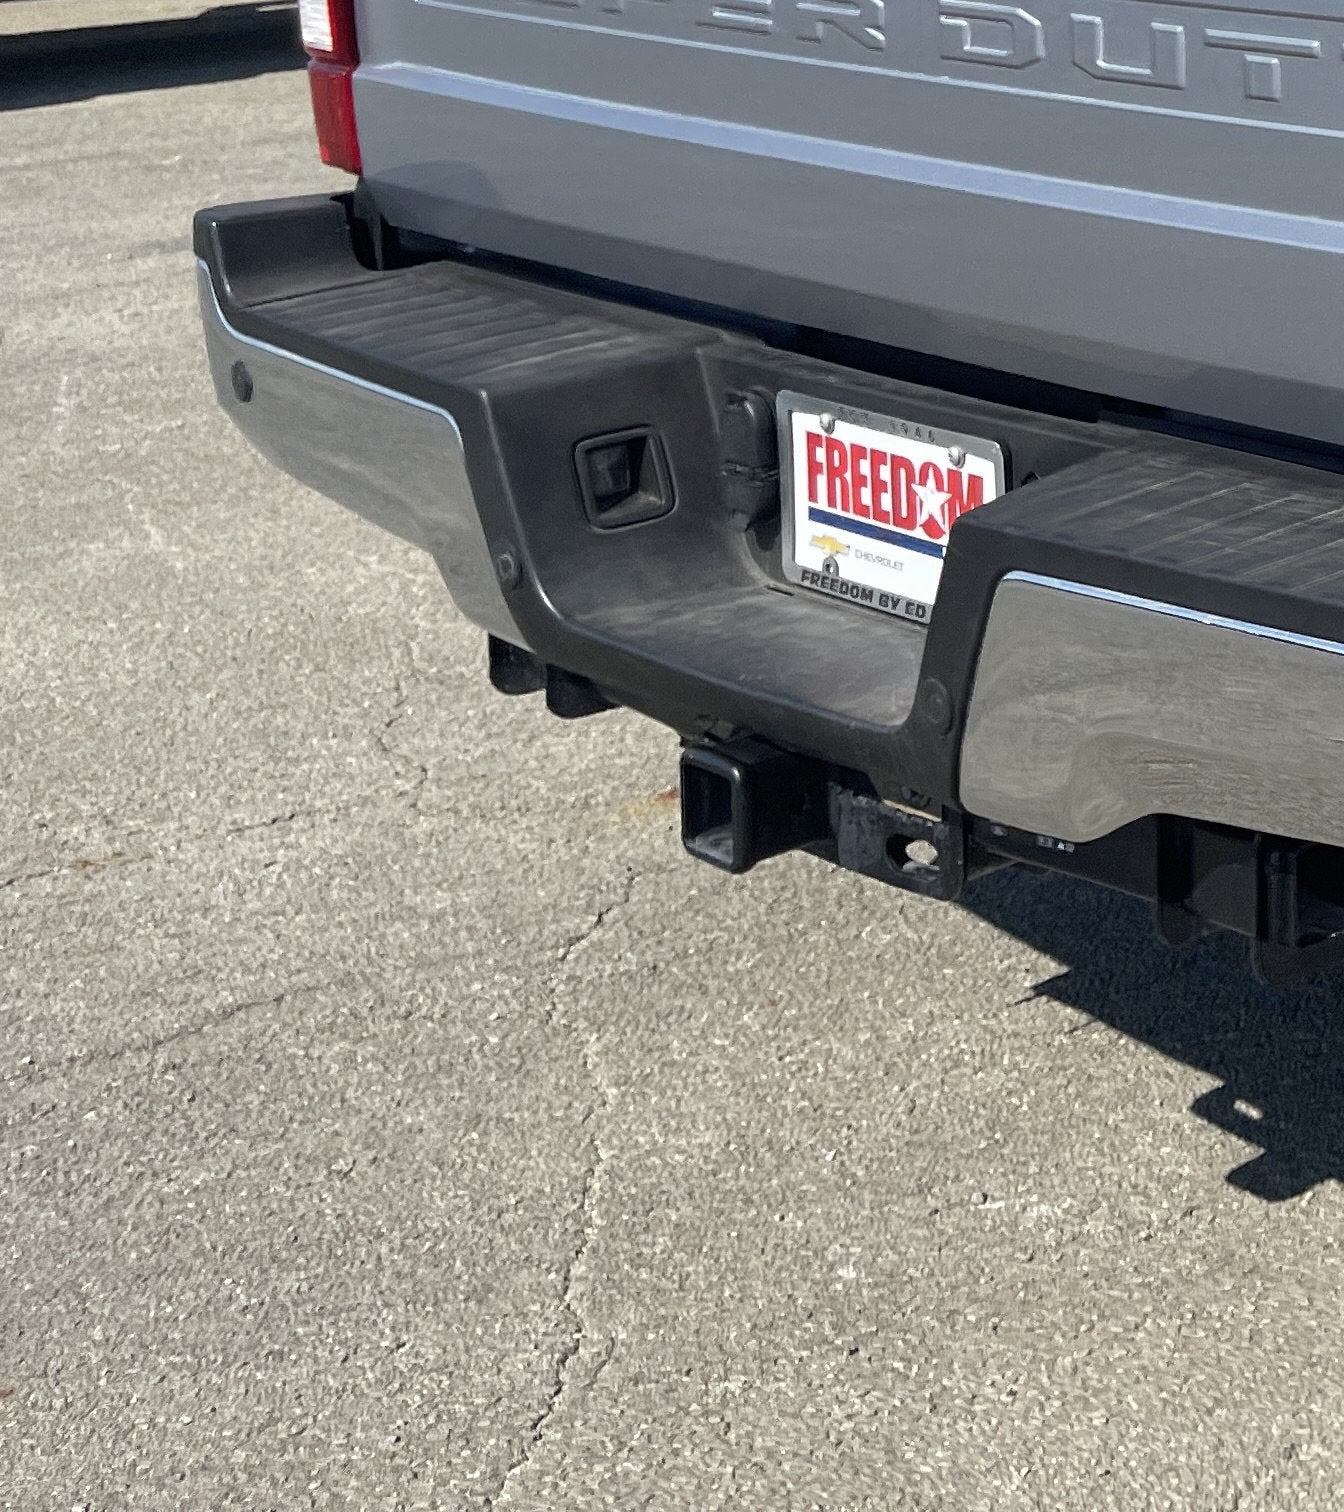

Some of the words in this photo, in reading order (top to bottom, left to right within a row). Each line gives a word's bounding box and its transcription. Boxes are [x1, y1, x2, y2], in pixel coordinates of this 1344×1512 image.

[806, 430, 984, 540] FREEDOM
[854, 548, 905, 571] CHEVROLET
[800, 568, 874, 603] FREEDOM
[878, 592, 901, 611] BY
[904, 600, 927, 619] ED
